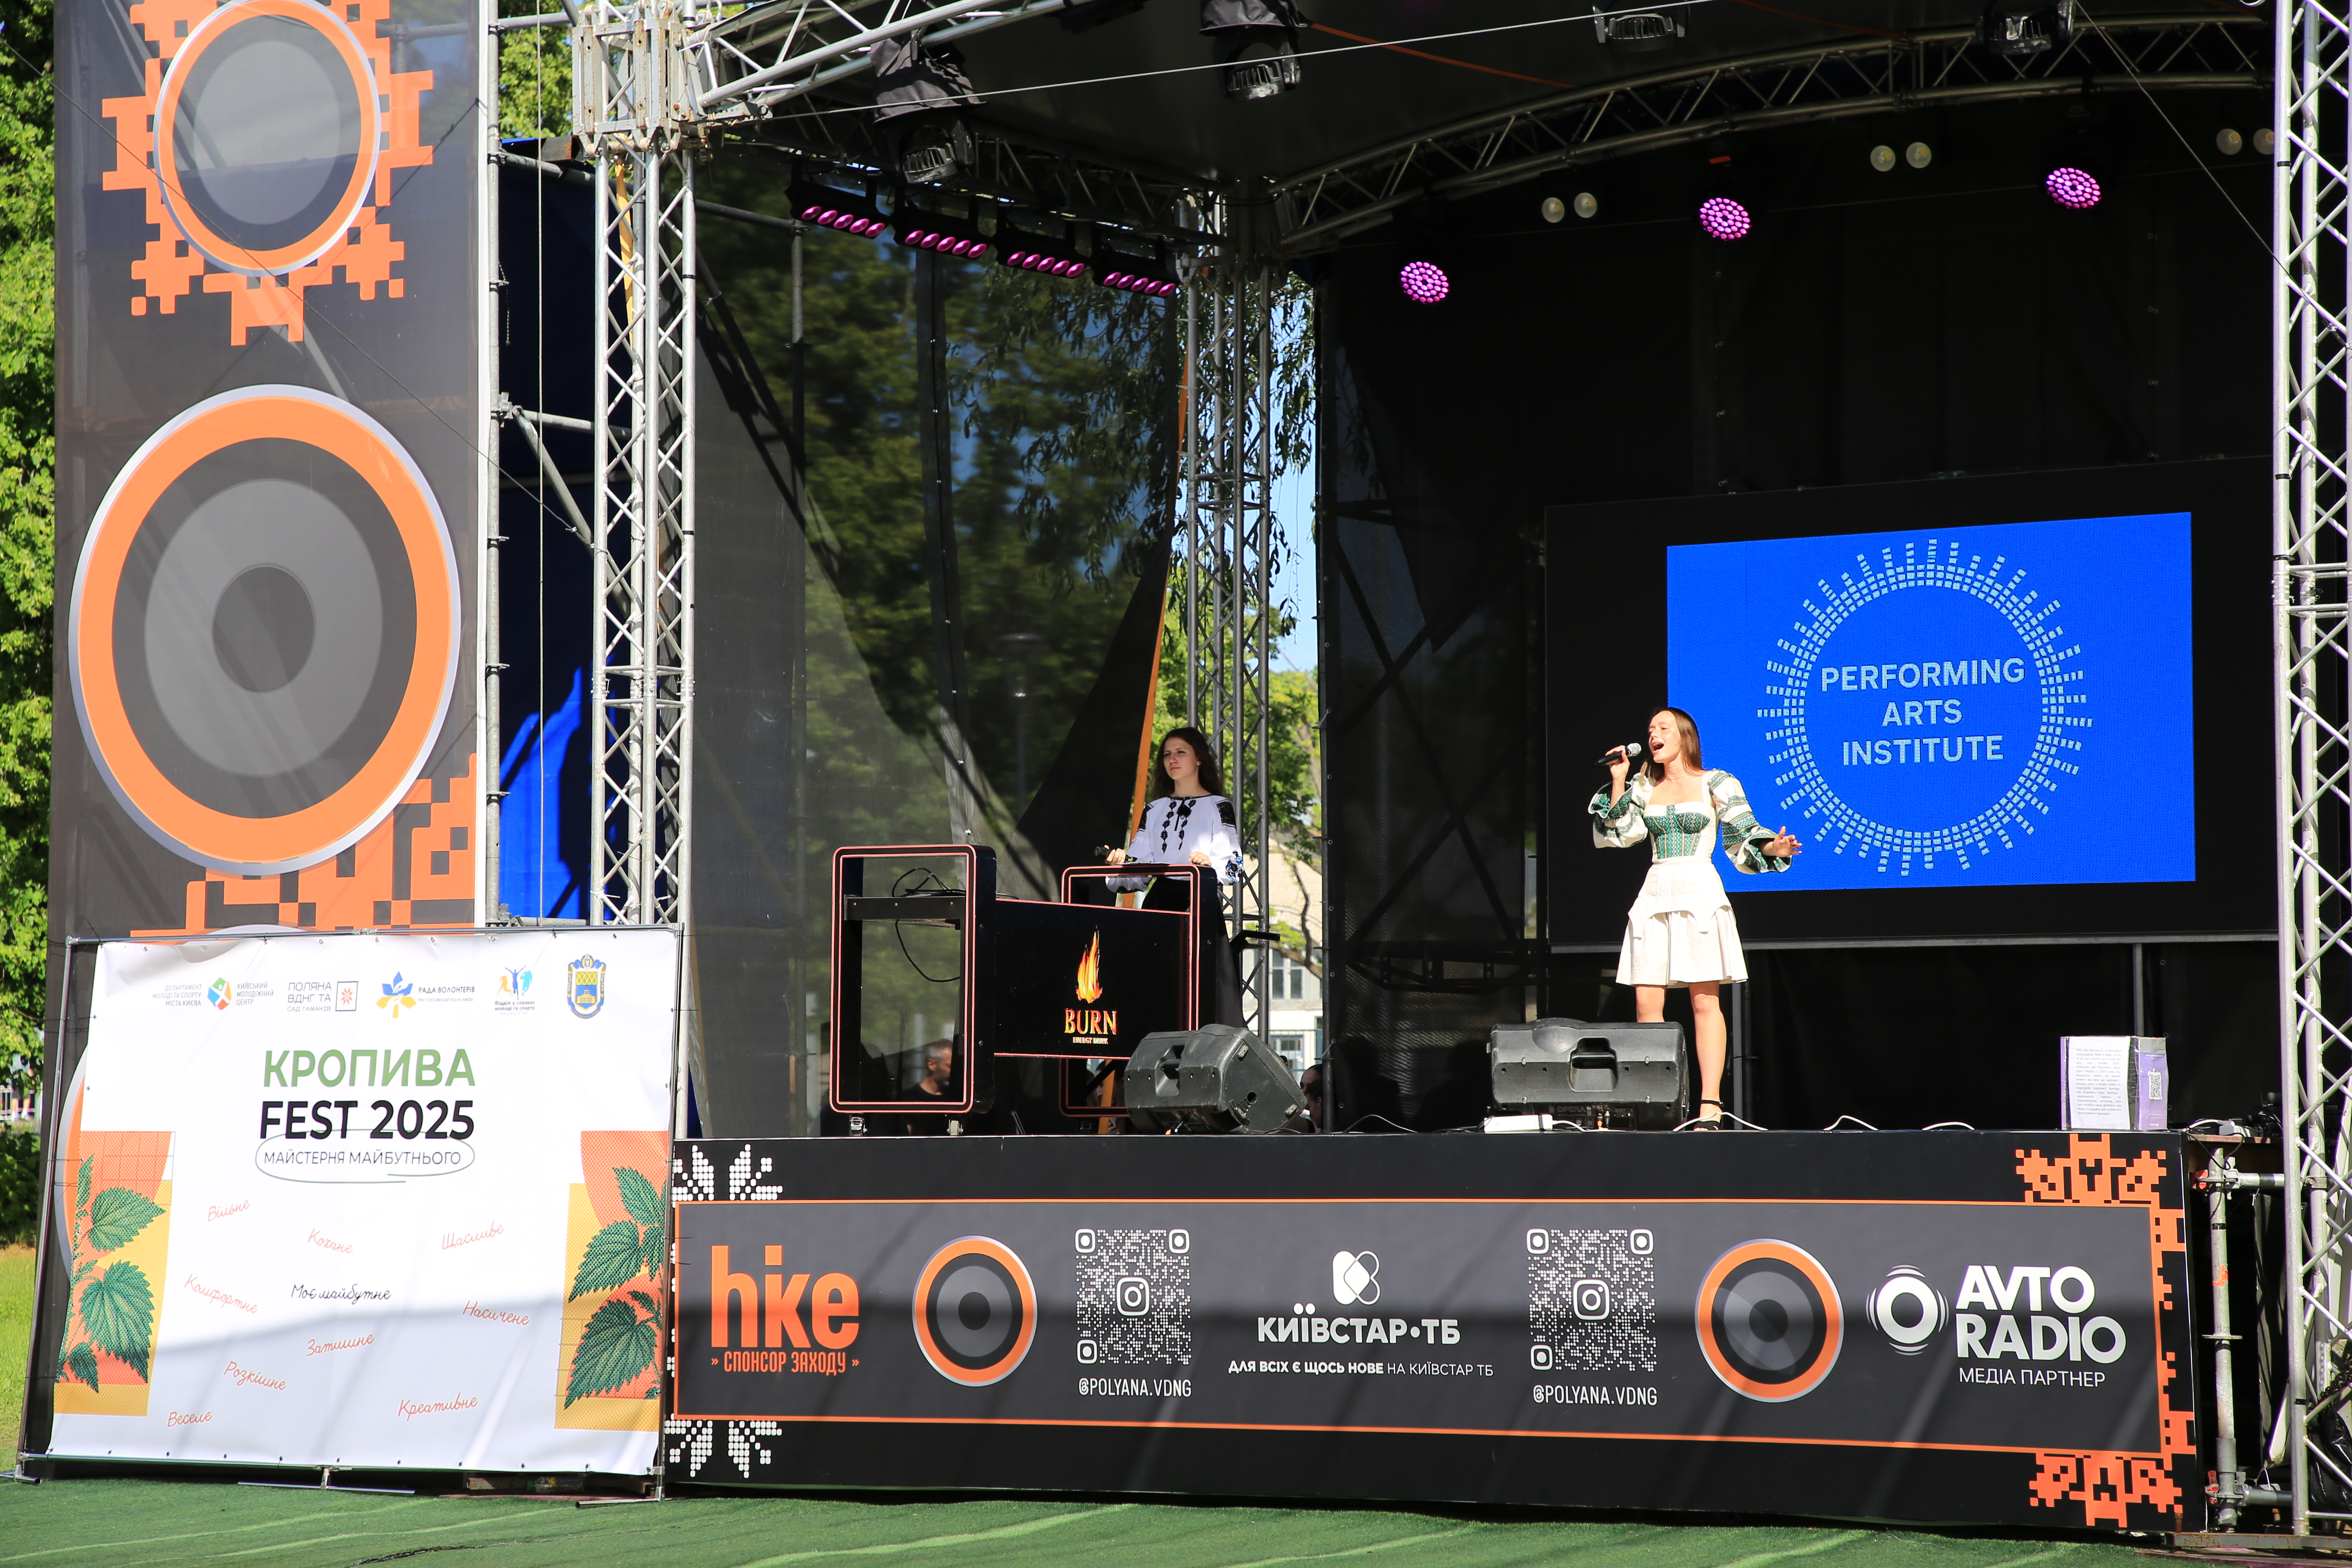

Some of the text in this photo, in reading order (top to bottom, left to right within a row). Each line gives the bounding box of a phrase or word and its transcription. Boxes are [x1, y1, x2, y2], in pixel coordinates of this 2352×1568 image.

[1821, 657, 2025, 692] PERFORMING
[1882, 698, 1963, 727] ARTS
[1843, 734, 2004, 766] INSTITUTE
[288, 982, 332, 991] ПОЛЯНА
[288, 994, 331, 1004] ВДНГ ТА
[1065, 1008, 1117, 1035] BURN
[263, 1049, 476, 1087] КРОПИВА
[260, 1099, 475, 1140] FEST 2025
[264, 1148, 461, 1165] МАЙСТЕРНЯ МАЙБУТНЬОГО
[207, 1200, 250, 1222] Вільне
[307, 1228, 354, 1254] Кохане
[441, 1220, 504, 1250] Щасливе
[184, 1273, 258, 1314] Комфортне
[291, 1283, 317, 1299] Моє
[710, 1244, 859, 1350] hike
[1955, 1265, 2096, 1314] AVTO
[462, 1299, 530, 1326] Насичене
[306, 1332, 375, 1357] Затишне
[1955, 1313, 2127, 1364] RADIO
[223, 1360, 287, 1391] Розкішне
[723, 1351, 846, 1376] СПОНСОР ЗАХОДУ
[1228, 1360, 1494, 1377] ДЛЯ ВСІХ Є ЩОСЬ НОВЕ НА КИЇВСТАР ТБ
[1078, 1378, 1192, 1398] @POLYANA.VDNG
[1959, 1367, 2105, 1388] МЕДІА ПАРТНЕР
[397, 1391, 479, 1422] Креативне
[1532, 1384, 1658, 1406] @POLYANA.VDNG
[166, 1409, 213, 1428] Веселе
